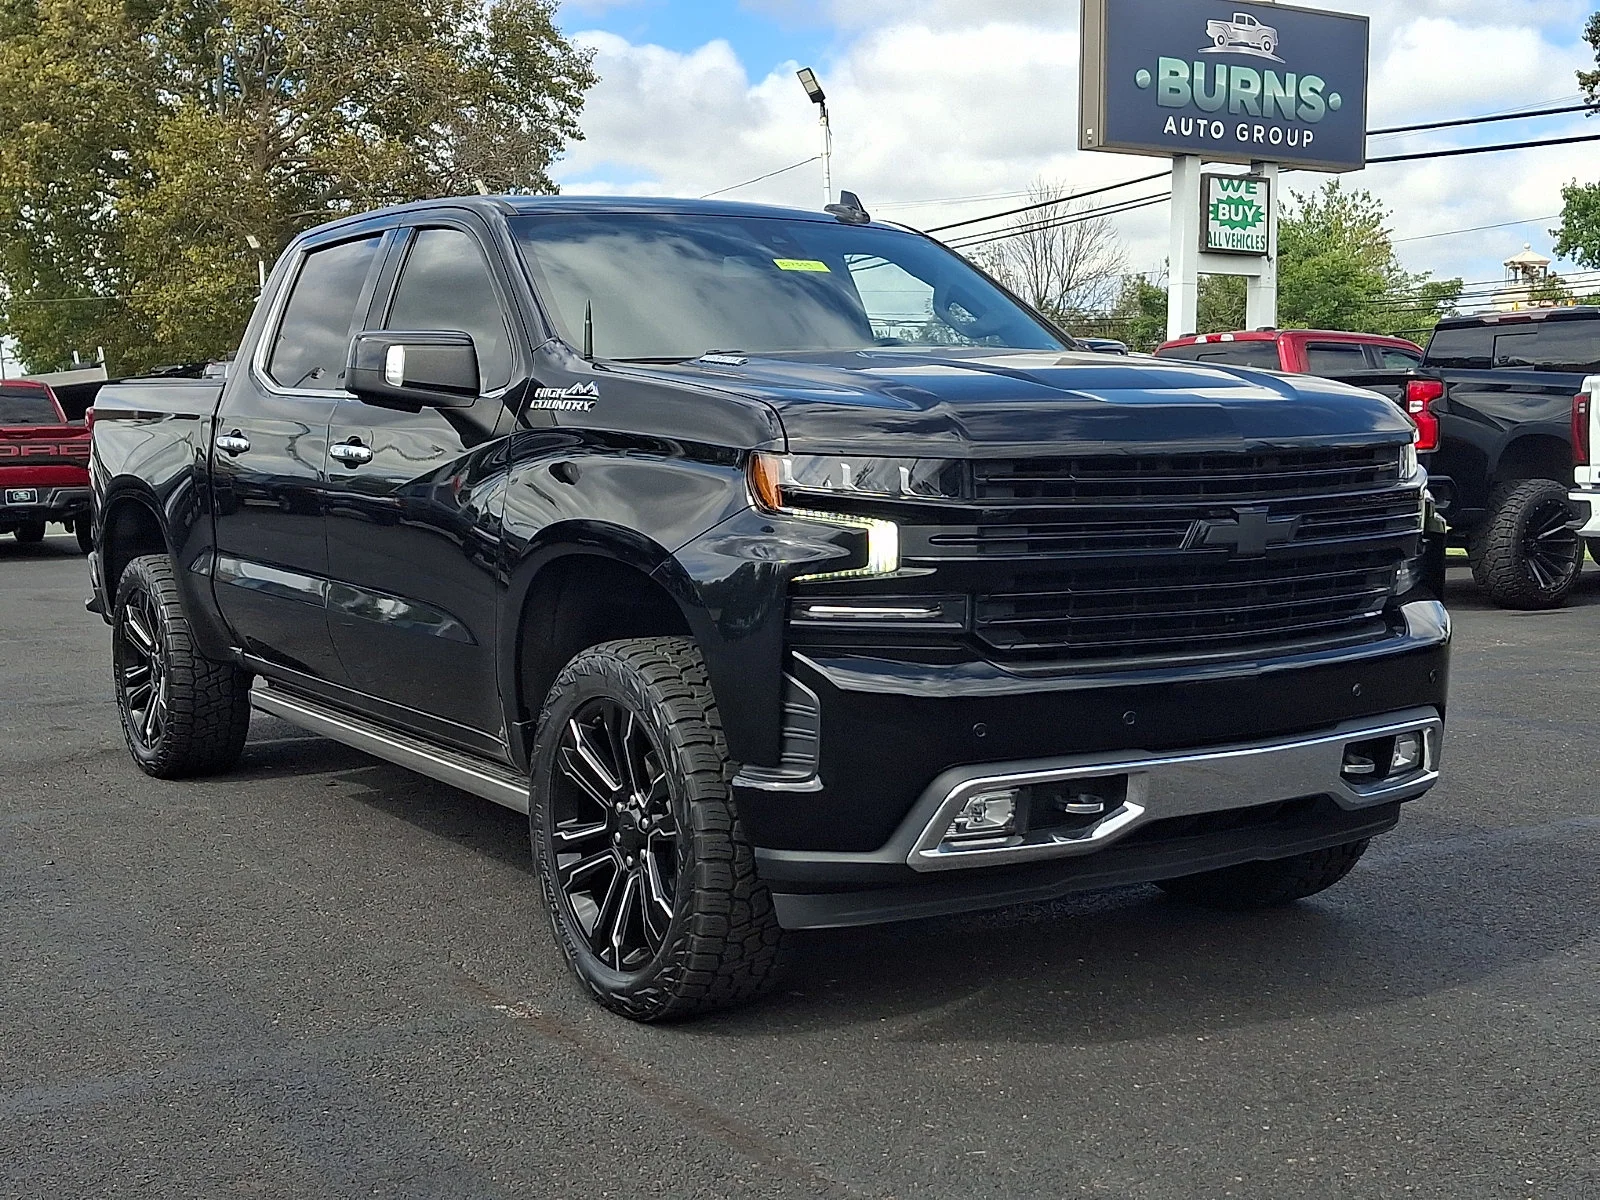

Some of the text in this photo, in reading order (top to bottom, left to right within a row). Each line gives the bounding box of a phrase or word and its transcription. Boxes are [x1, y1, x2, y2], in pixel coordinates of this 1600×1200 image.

[1157, 56, 1326, 123] BURNS
[1163, 115, 1314, 148] AUTO GROUP
[1217, 177, 1258, 194] WE
[1218, 203, 1257, 222] BUY
[1208, 230, 1266, 251] ALL VEHICLES
[534, 387, 568, 399] HIGH
[530, 399, 597, 412] COUNTRY
